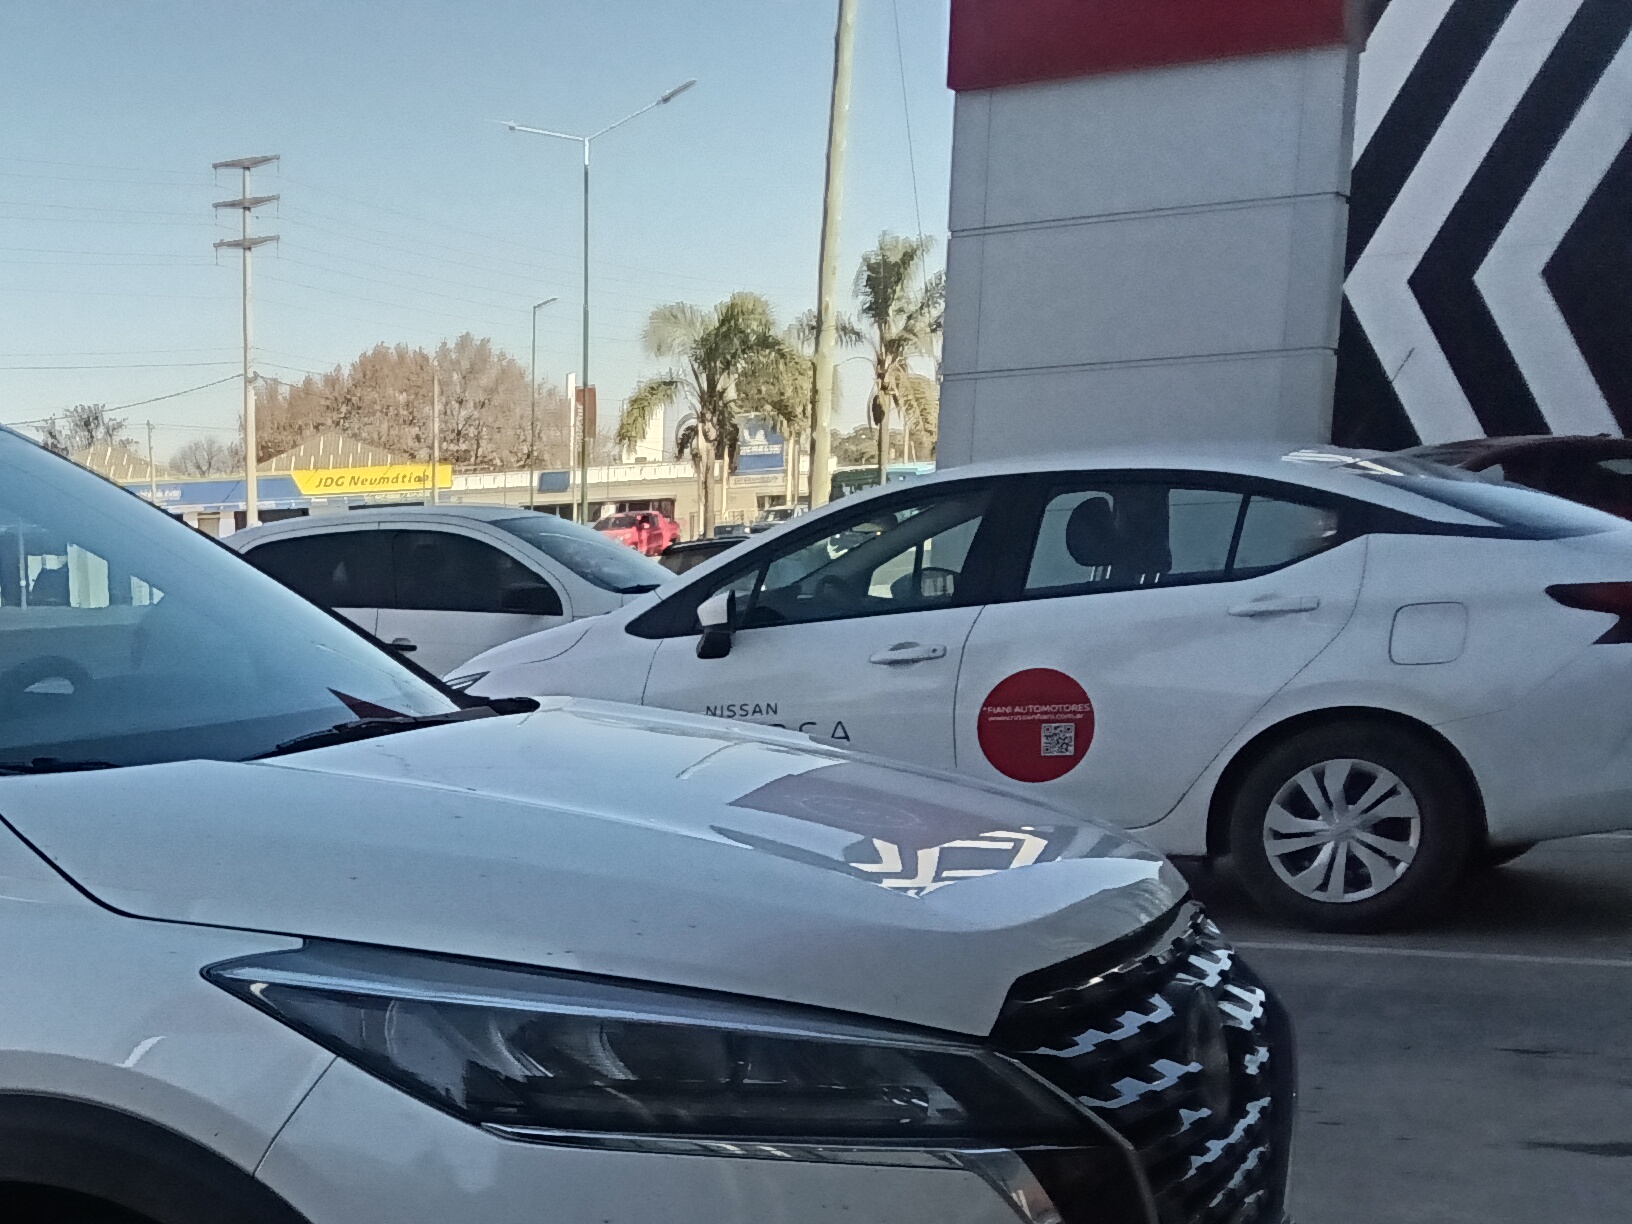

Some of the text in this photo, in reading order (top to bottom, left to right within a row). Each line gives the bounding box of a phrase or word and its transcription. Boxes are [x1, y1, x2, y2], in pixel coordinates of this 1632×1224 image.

[315, 476, 346, 488] JDG
[705, 702, 778, 718] NISSAN
[1014, 704, 1090, 713] AUTOMOTORES
